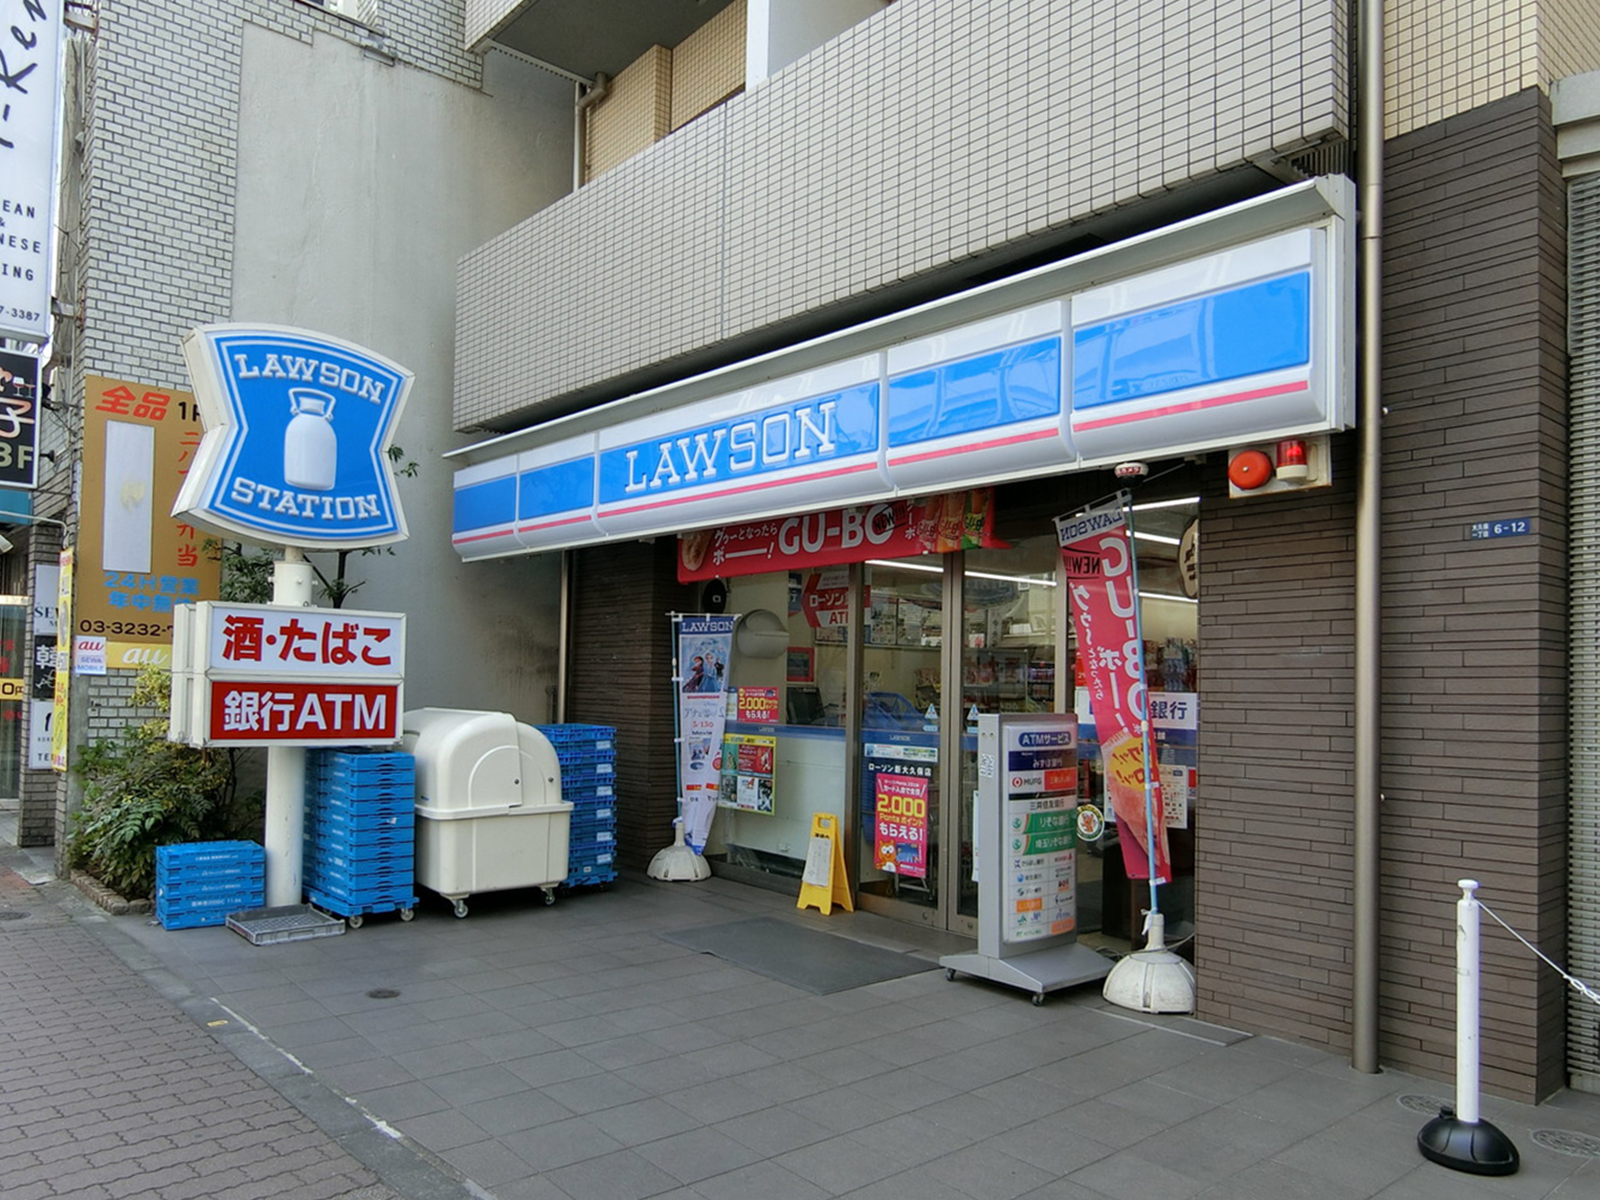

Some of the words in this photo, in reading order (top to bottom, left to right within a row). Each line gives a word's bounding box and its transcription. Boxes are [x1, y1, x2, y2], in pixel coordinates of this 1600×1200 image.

[234, 353, 386, 404] LAWSON
[95, 385, 171, 421] 全品
[625, 401, 836, 493] LAWSON
[230, 476, 381, 520] STATION
[1493, 521, 1526, 535] 6-12
[104, 571, 200, 596] 24H営業
[809, 592, 849, 608] ローソン
[681, 621, 734, 633] LAWSON
[78, 640, 105, 652] au
[222, 614, 392, 667] 酒・たばこ
[122, 646, 169, 665] au
[222, 690, 388, 732] 銀行ATM
[1150, 700, 1188, 720] 銀行
[1021, 733, 1070, 747] ATMサービス
[877, 793, 926, 818] 2,000
[879, 821, 924, 842] もらえる!
